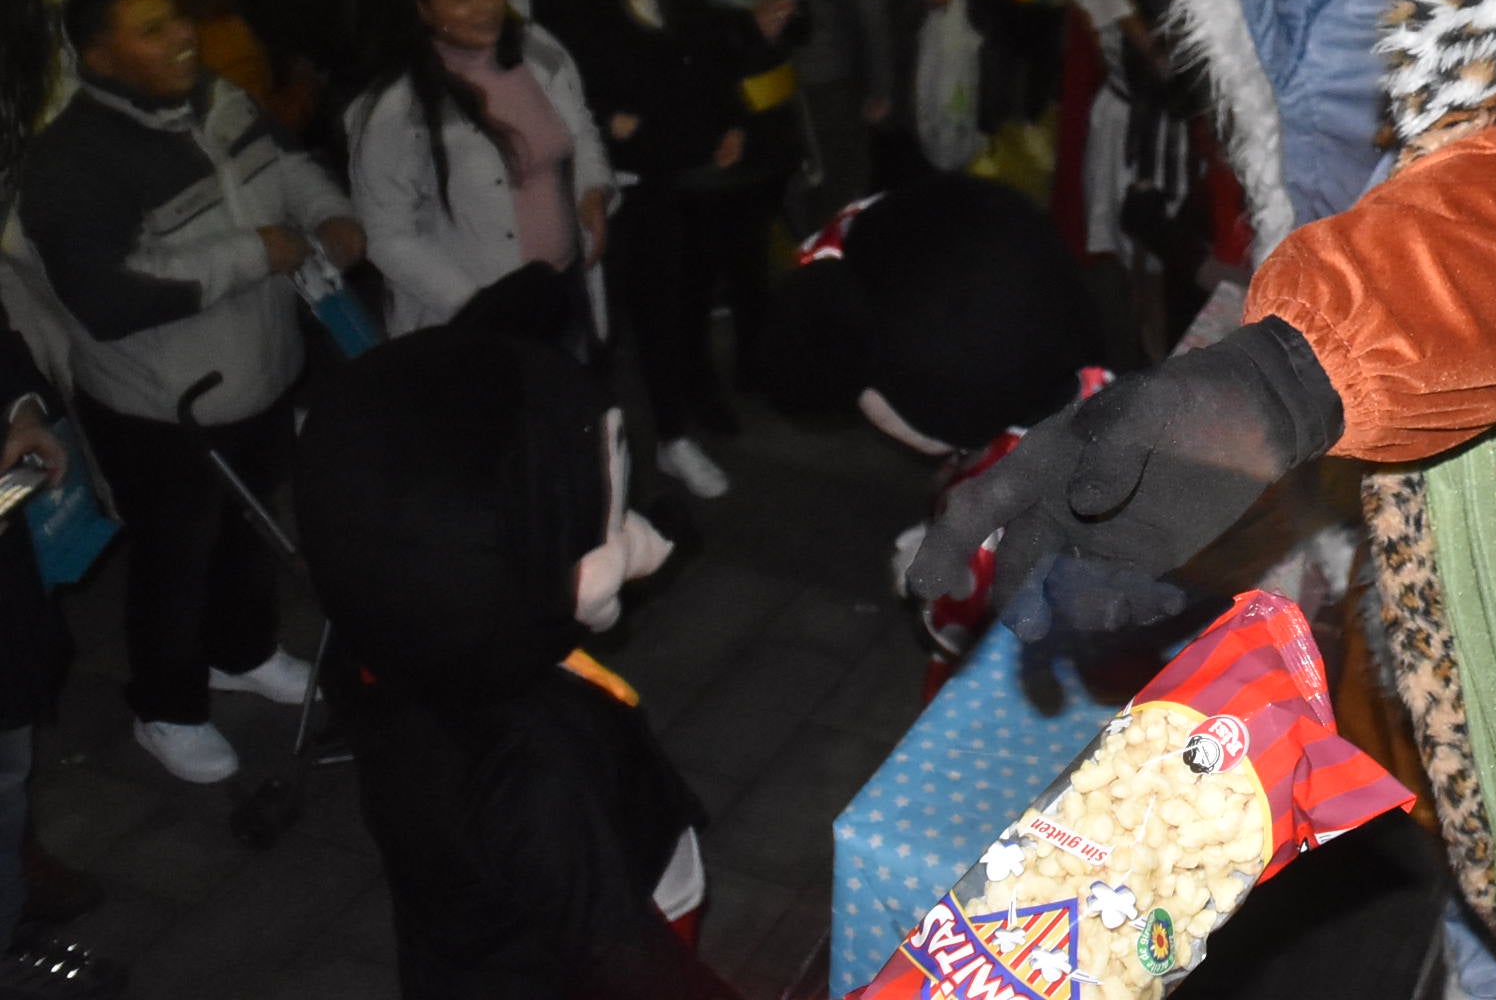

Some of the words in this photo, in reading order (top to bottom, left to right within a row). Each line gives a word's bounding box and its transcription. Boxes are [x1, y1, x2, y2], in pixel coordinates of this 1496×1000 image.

[1030, 818, 1082, 849] gluten
[1080, 844, 1107, 861] sin
[910, 903, 1029, 1000] MITAS
